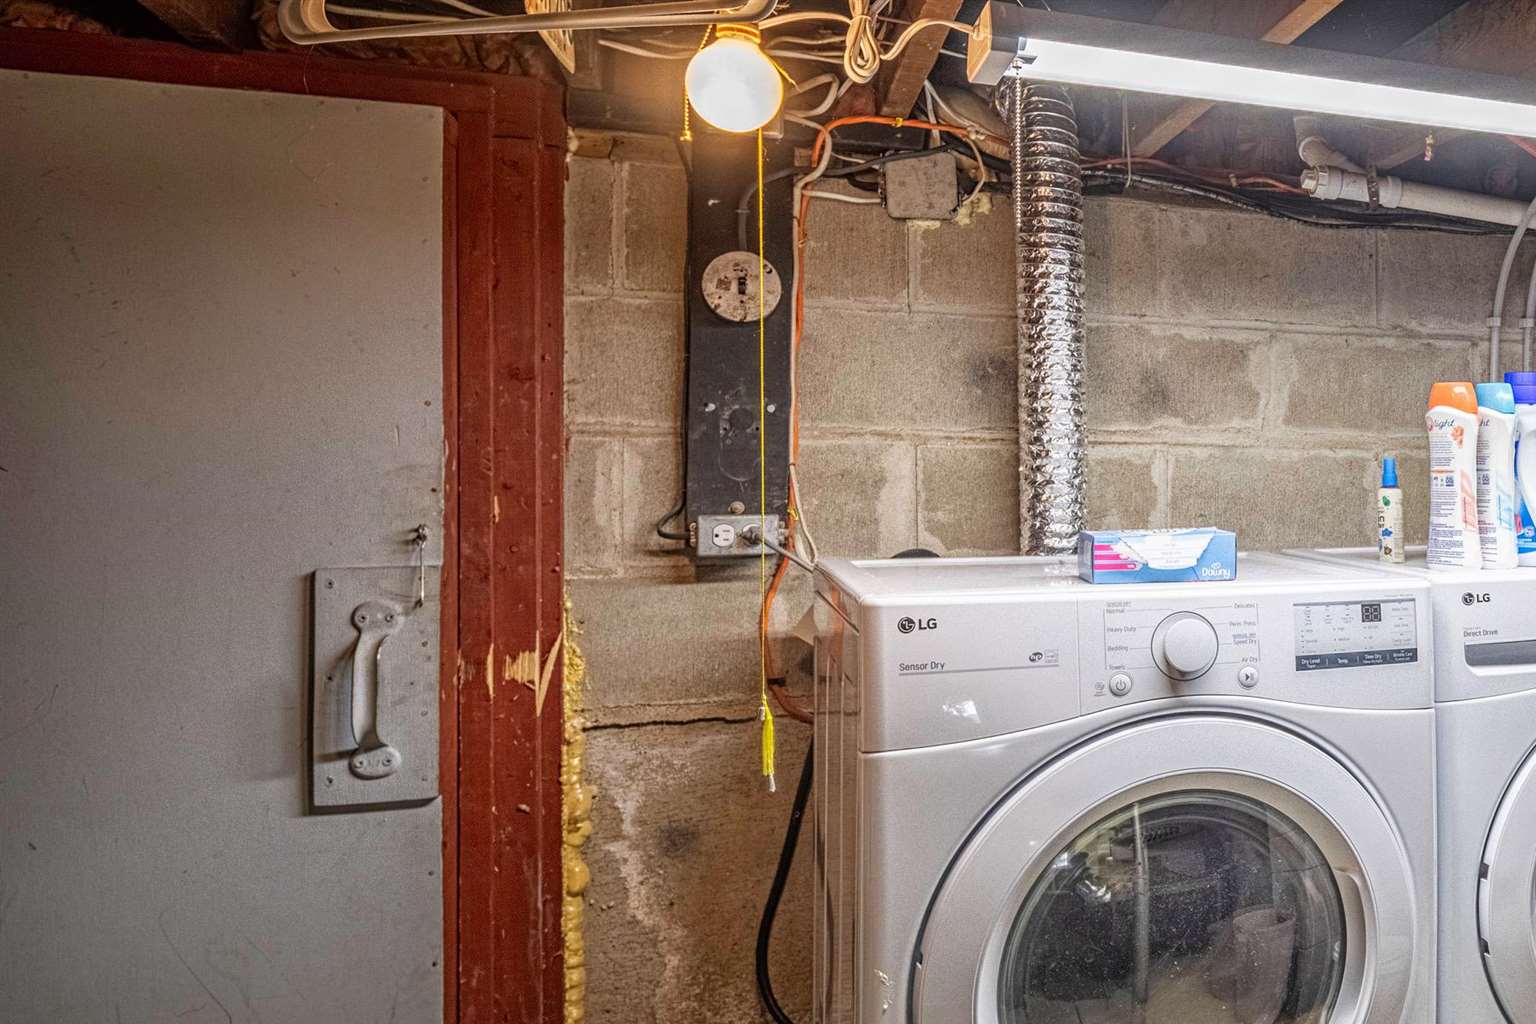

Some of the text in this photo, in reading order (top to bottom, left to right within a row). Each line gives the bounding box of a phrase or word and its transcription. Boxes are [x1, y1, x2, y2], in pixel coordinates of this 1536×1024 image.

[1202, 566, 1231, 579] Downy
[1476, 593, 1491, 603] LG
[918, 618, 938, 630] LG
[1482, 629, 1498, 637] Drive
[899, 661, 945, 672] Sensor Dry
